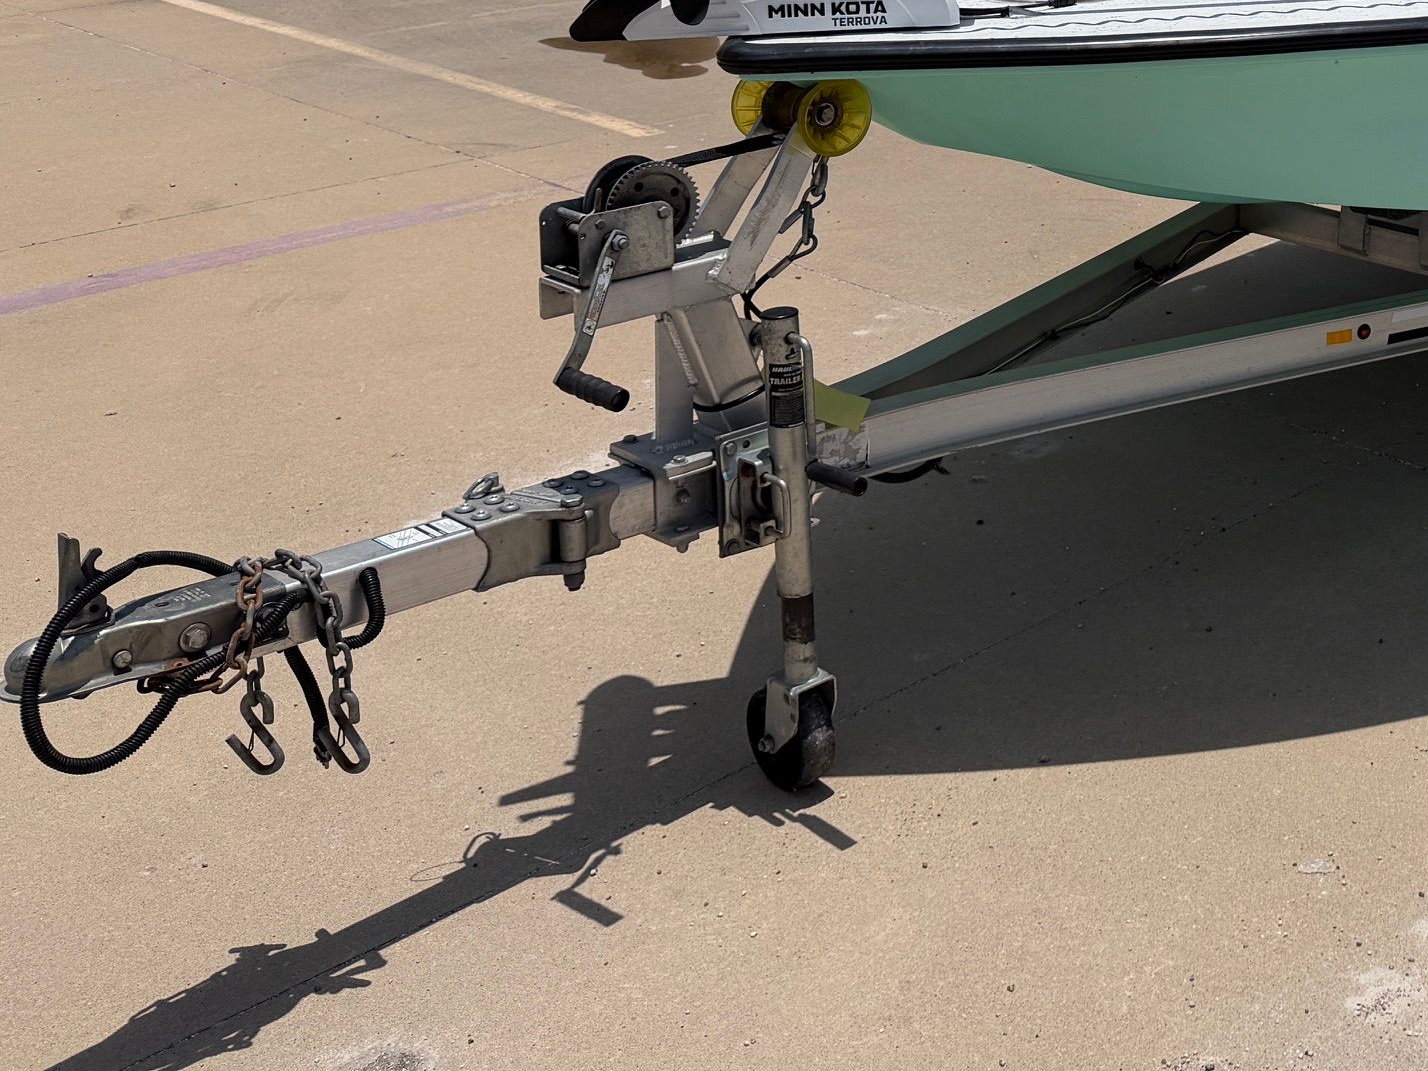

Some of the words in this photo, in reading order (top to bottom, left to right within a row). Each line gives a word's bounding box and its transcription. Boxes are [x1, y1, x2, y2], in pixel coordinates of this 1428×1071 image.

[767, 2, 826, 19] MINN
[831, 0, 888, 16] KOTA
[831, 16, 888, 27] TERROVA
